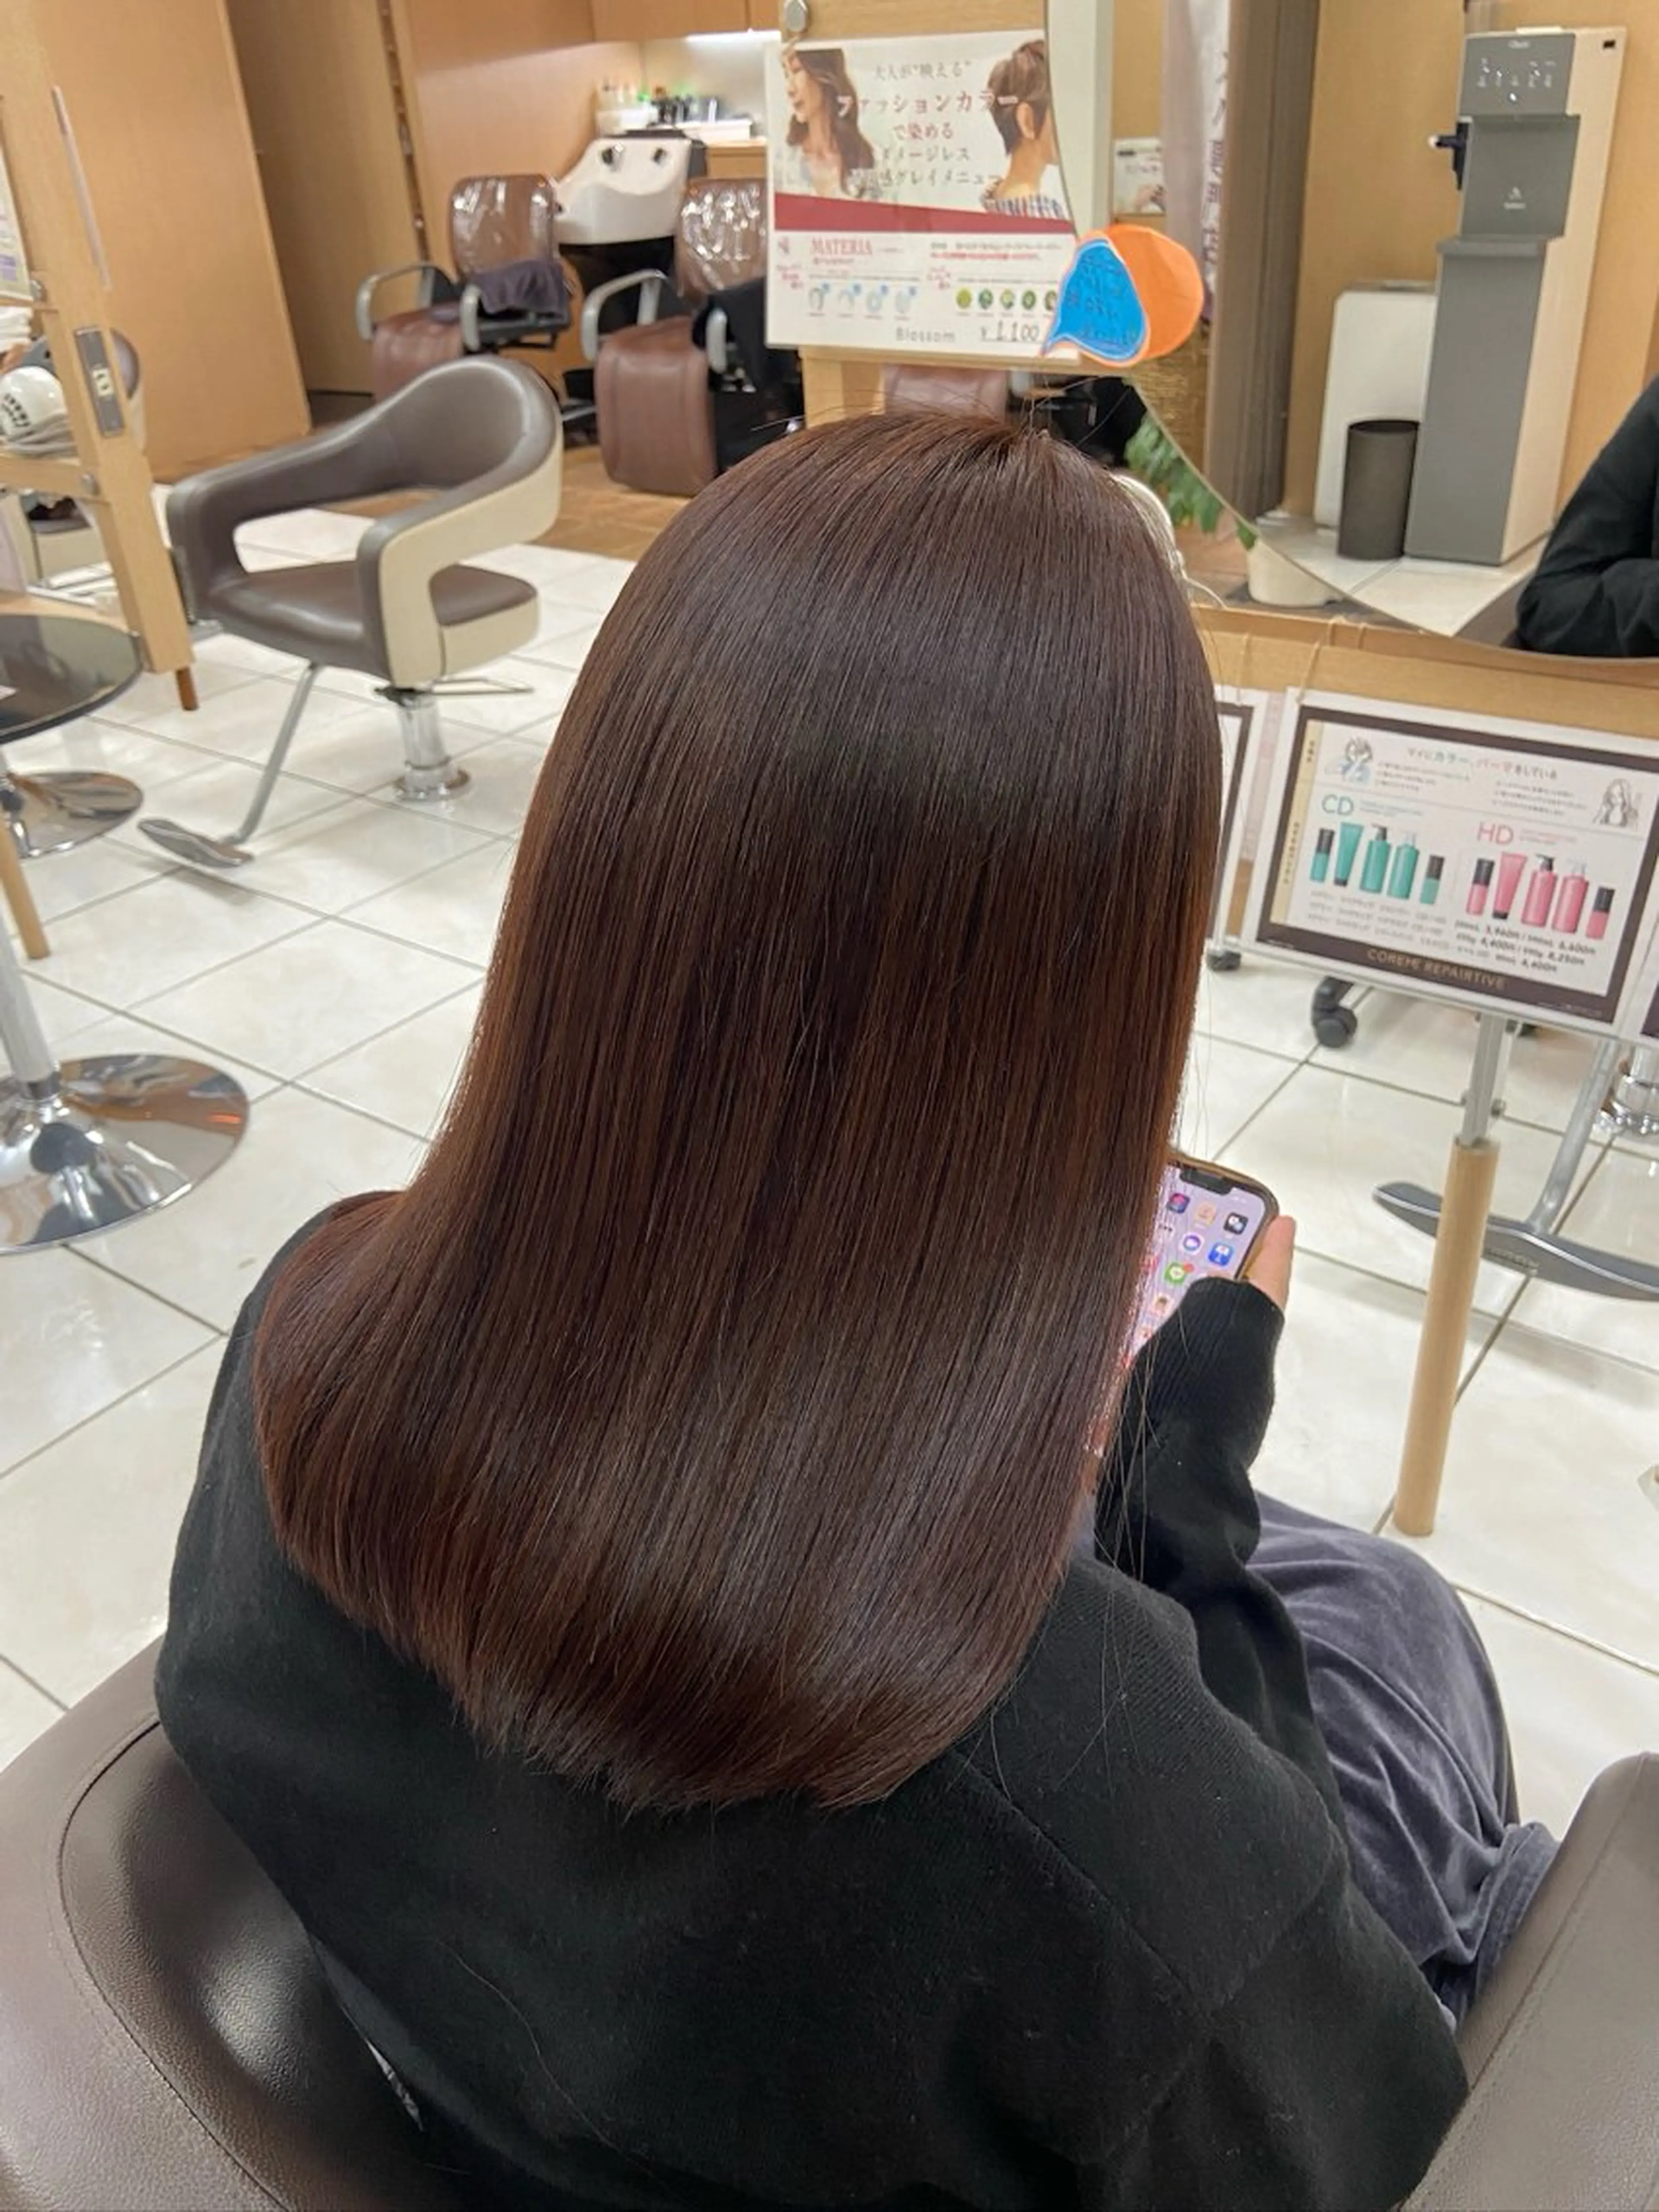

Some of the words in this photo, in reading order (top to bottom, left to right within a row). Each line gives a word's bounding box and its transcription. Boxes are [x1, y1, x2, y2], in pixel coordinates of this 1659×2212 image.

[836, 90, 1019, 117] ファッションカラー
[893, 122, 953, 140] で染める
[810, 239, 873, 255] MATERIA
[896, 326, 955, 343] Blossom
[1322, 794, 1354, 816] CD
[1477, 822, 1514, 845] HD
